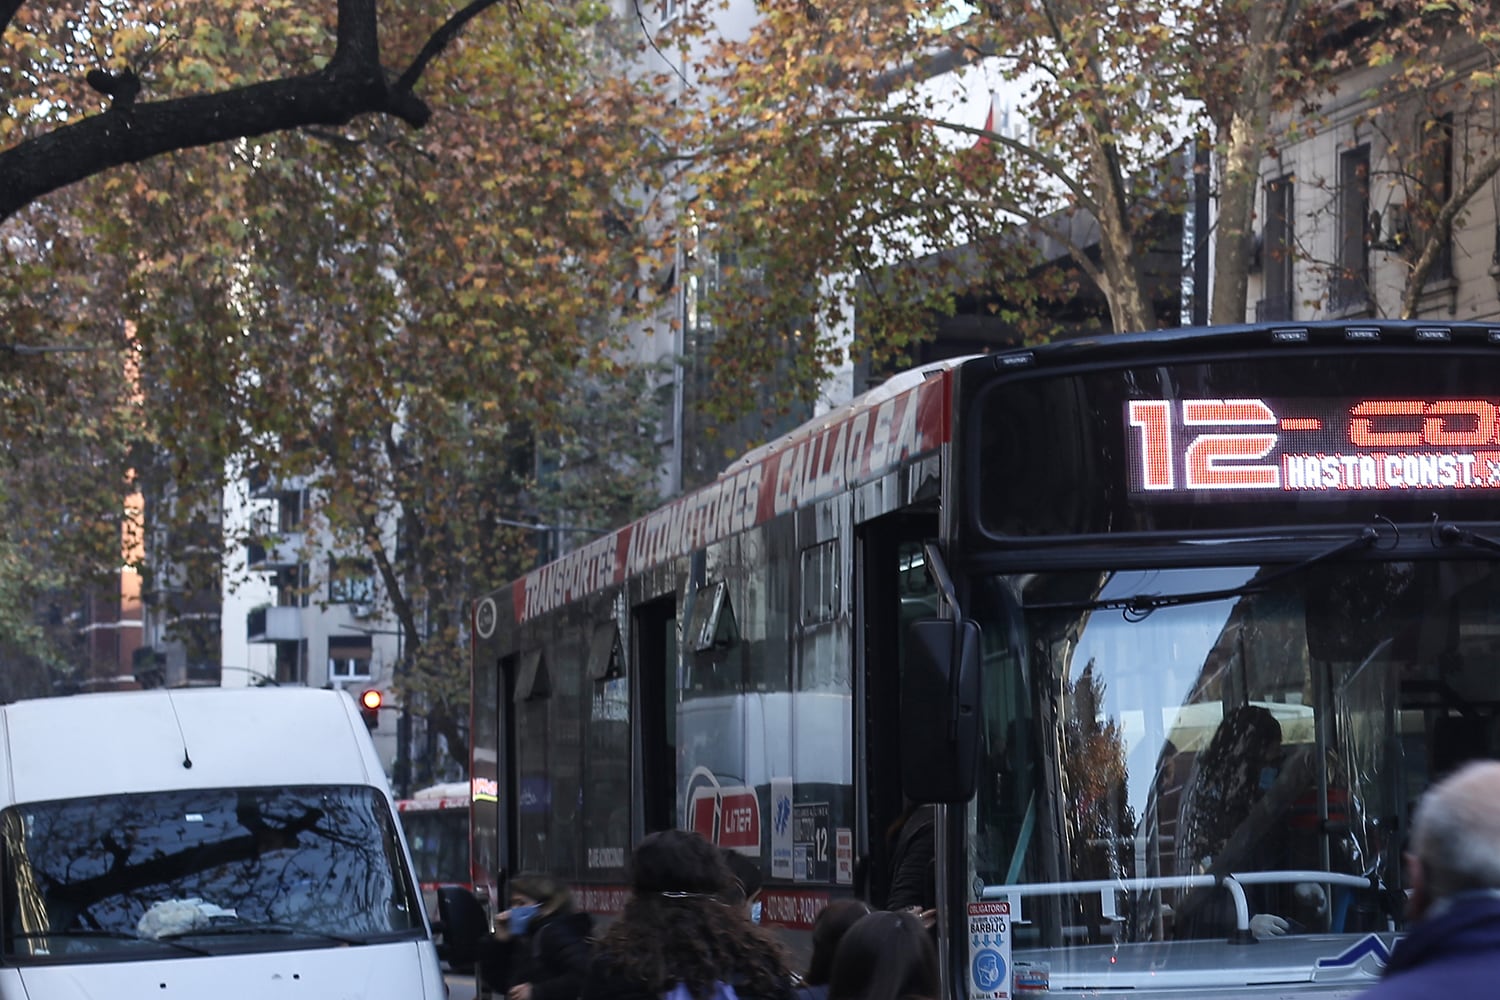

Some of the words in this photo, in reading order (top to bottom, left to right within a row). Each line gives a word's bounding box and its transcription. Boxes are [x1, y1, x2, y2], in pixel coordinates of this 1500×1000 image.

[1286, 454, 1378, 490] HASTA
[1384, 454, 1483, 489] CONST.
[524, 534, 618, 621] TRANSPORTES
[625, 464, 762, 580] AUTOMOTORES
[774, 411, 869, 515] CALLAO
[815, 827, 828, 861] 12
[969, 903, 1008, 914] OBLIGATORIO
[970, 923, 1006, 934] BARBIJO
